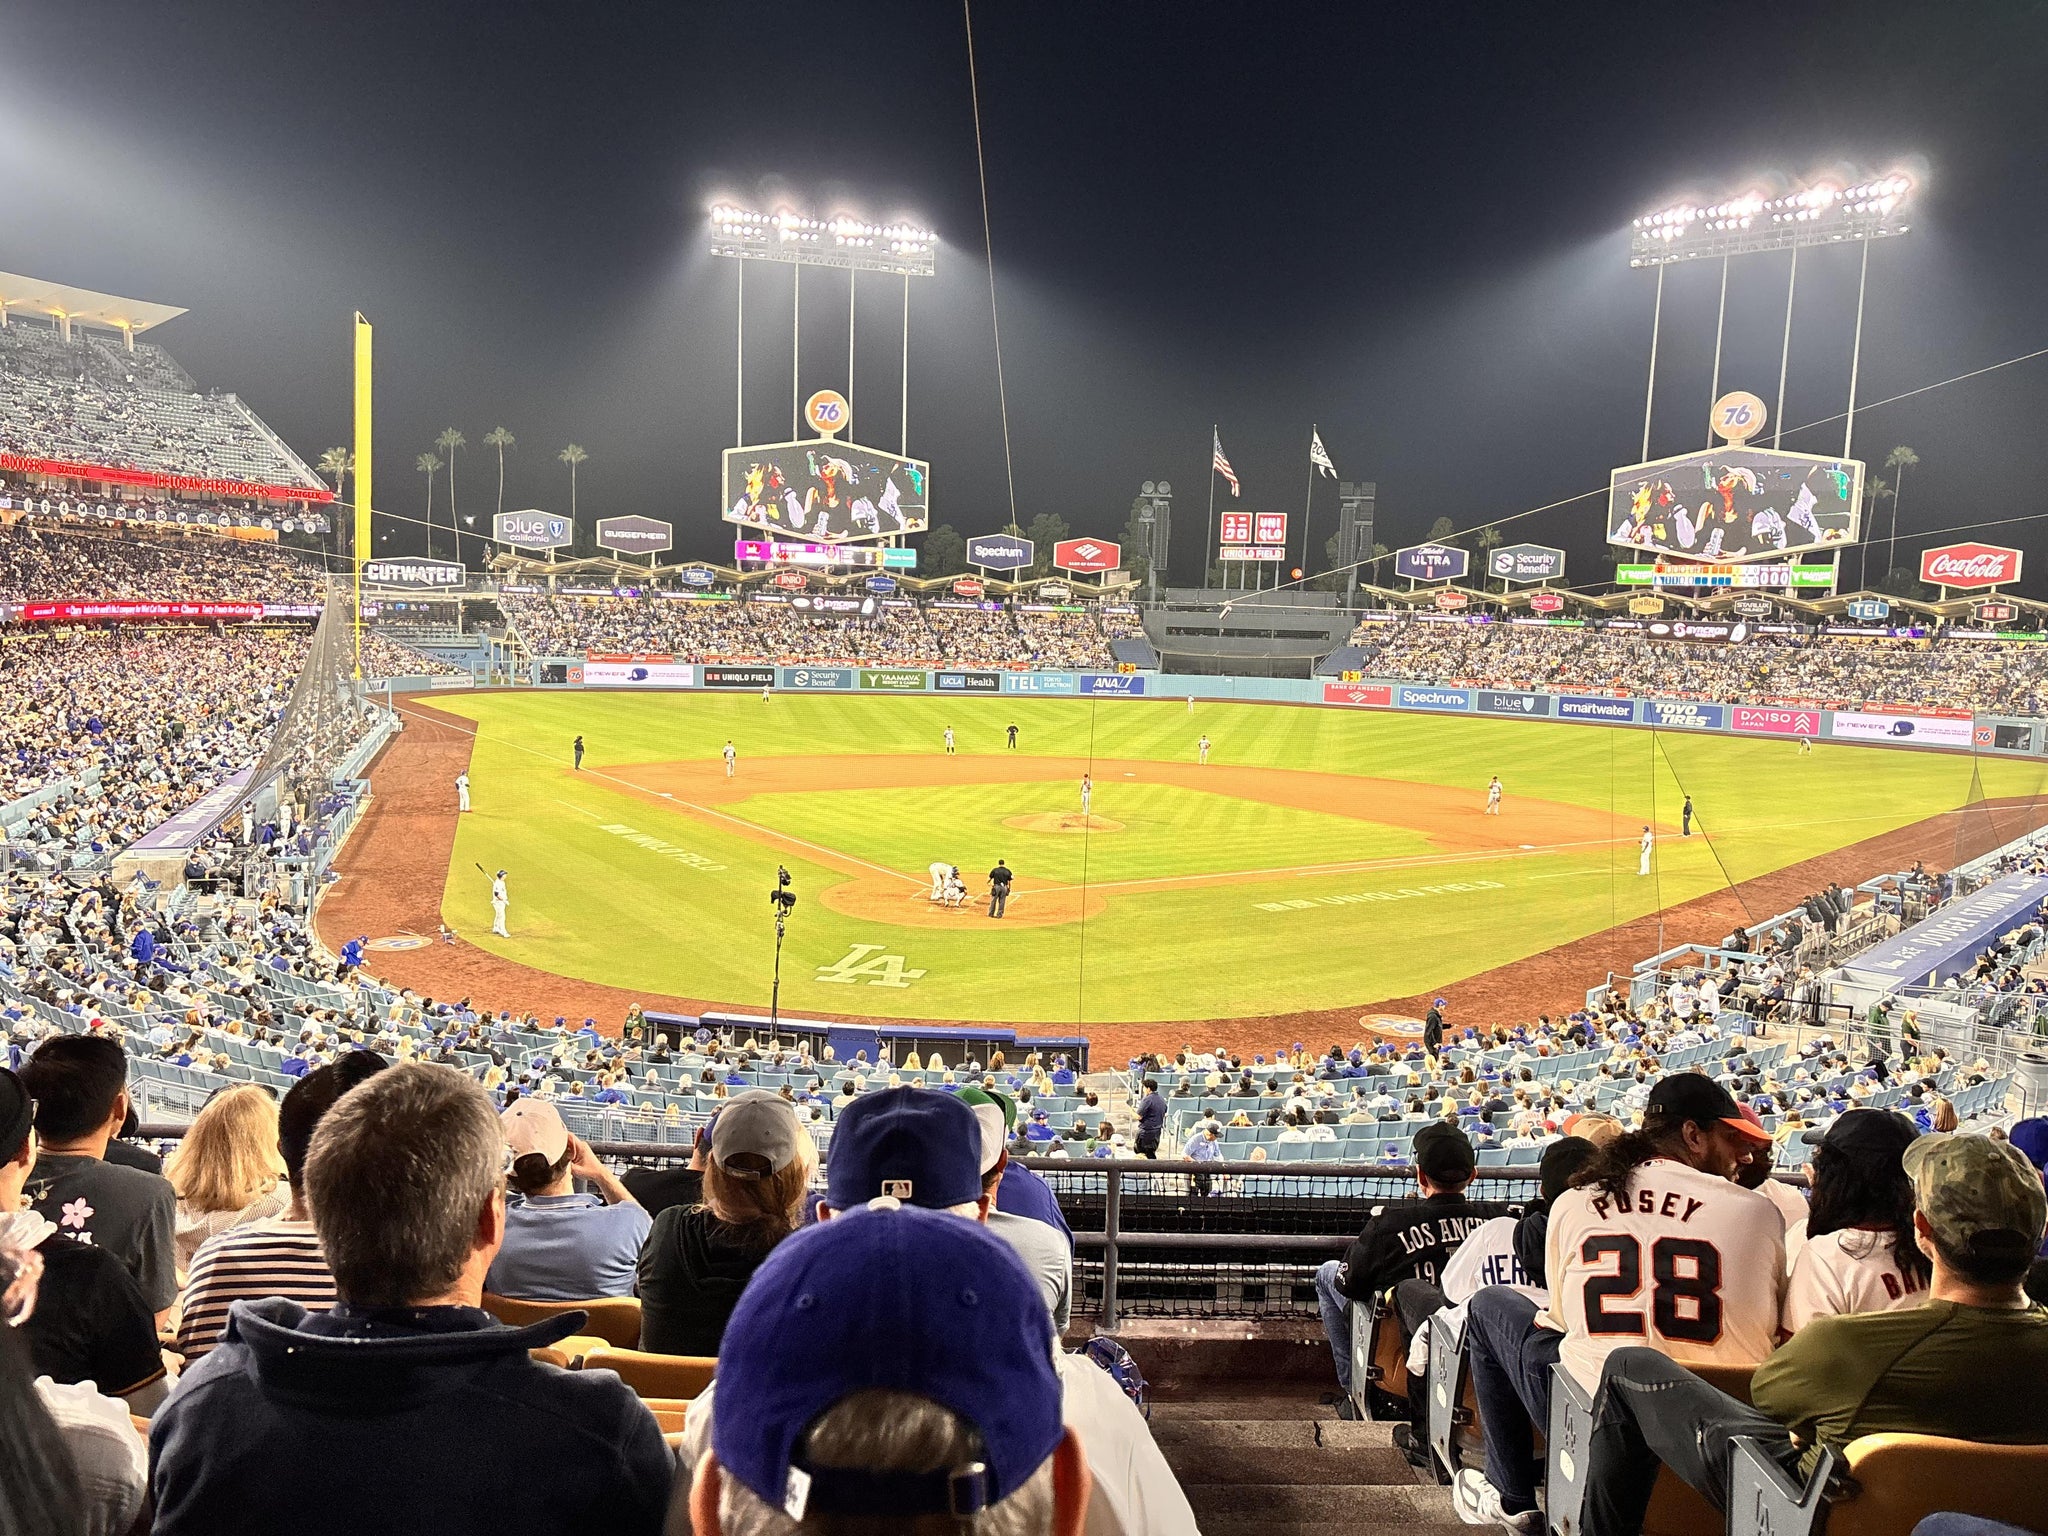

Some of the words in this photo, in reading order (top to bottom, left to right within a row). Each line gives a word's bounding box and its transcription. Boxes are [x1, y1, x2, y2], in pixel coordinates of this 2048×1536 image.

[815, 402, 842, 422] 76
[1720, 404, 1753, 426] 76
[10, 456, 45, 473] DODGERS
[57, 464, 89, 478] SEATGEEK
[154, 473, 170, 488] THE
[171, 476, 188, 490] LOS
[189, 478, 227, 494] ANGELES
[228, 481, 270, 497] DODGERS
[285, 489, 322, 500] SEATGEEK
[503, 516, 545, 534] blue
[1259, 517, 1281, 529] UNI
[509, 533, 550, 543] california
[1259, 528, 1283, 541] QLO
[974, 545, 1023, 558] Spectrum
[1223, 549, 1255, 559] UNIQLO
[1256, 549, 1282, 558] FIELD
[1411, 555, 1451, 566] ULTRA
[1516, 552, 1556, 567] Security
[1928, 553, 2010, 578] Coca-Cola
[367, 563, 459, 584] CUTWATER
[1516, 563, 1550, 575] Benefit
[781, 576, 802, 585] JINRO
[1854, 603, 1884, 617] TEL
[1117, 662, 1136, 674] 0:30
[722, 673, 749, 682] UNIQLO
[750, 674, 773, 682] FIELD
[811, 671, 840, 681] Security
[811, 678, 837, 687] Benefit
[942, 677, 962, 686] UCLA
[966, 677, 995, 687] Health
[1009, 676, 1039, 690] TEL
[1093, 677, 1119, 688] ANA
[1403, 690, 1460, 706] Spectrum
[1494, 695, 1522, 709] blue
[1562, 702, 1629, 717] smartwater
[1655, 703, 1698, 715] TOYO
[1661, 714, 1708, 726] TIRES
[1741, 710, 1791, 724] DAISO
[1976, 732, 1991, 741] 76
[1315, 888, 1425, 906] UNIQLO
[1420, 880, 1507, 895] FIELD
[1910, 916, 1982, 948] DODGER
[814, 943, 928, 988] LA
[1591, 1189, 1704, 1223] POSEY
[1397, 1222, 1436, 1254] LOS
[1581, 1233, 1724, 1347] 28
